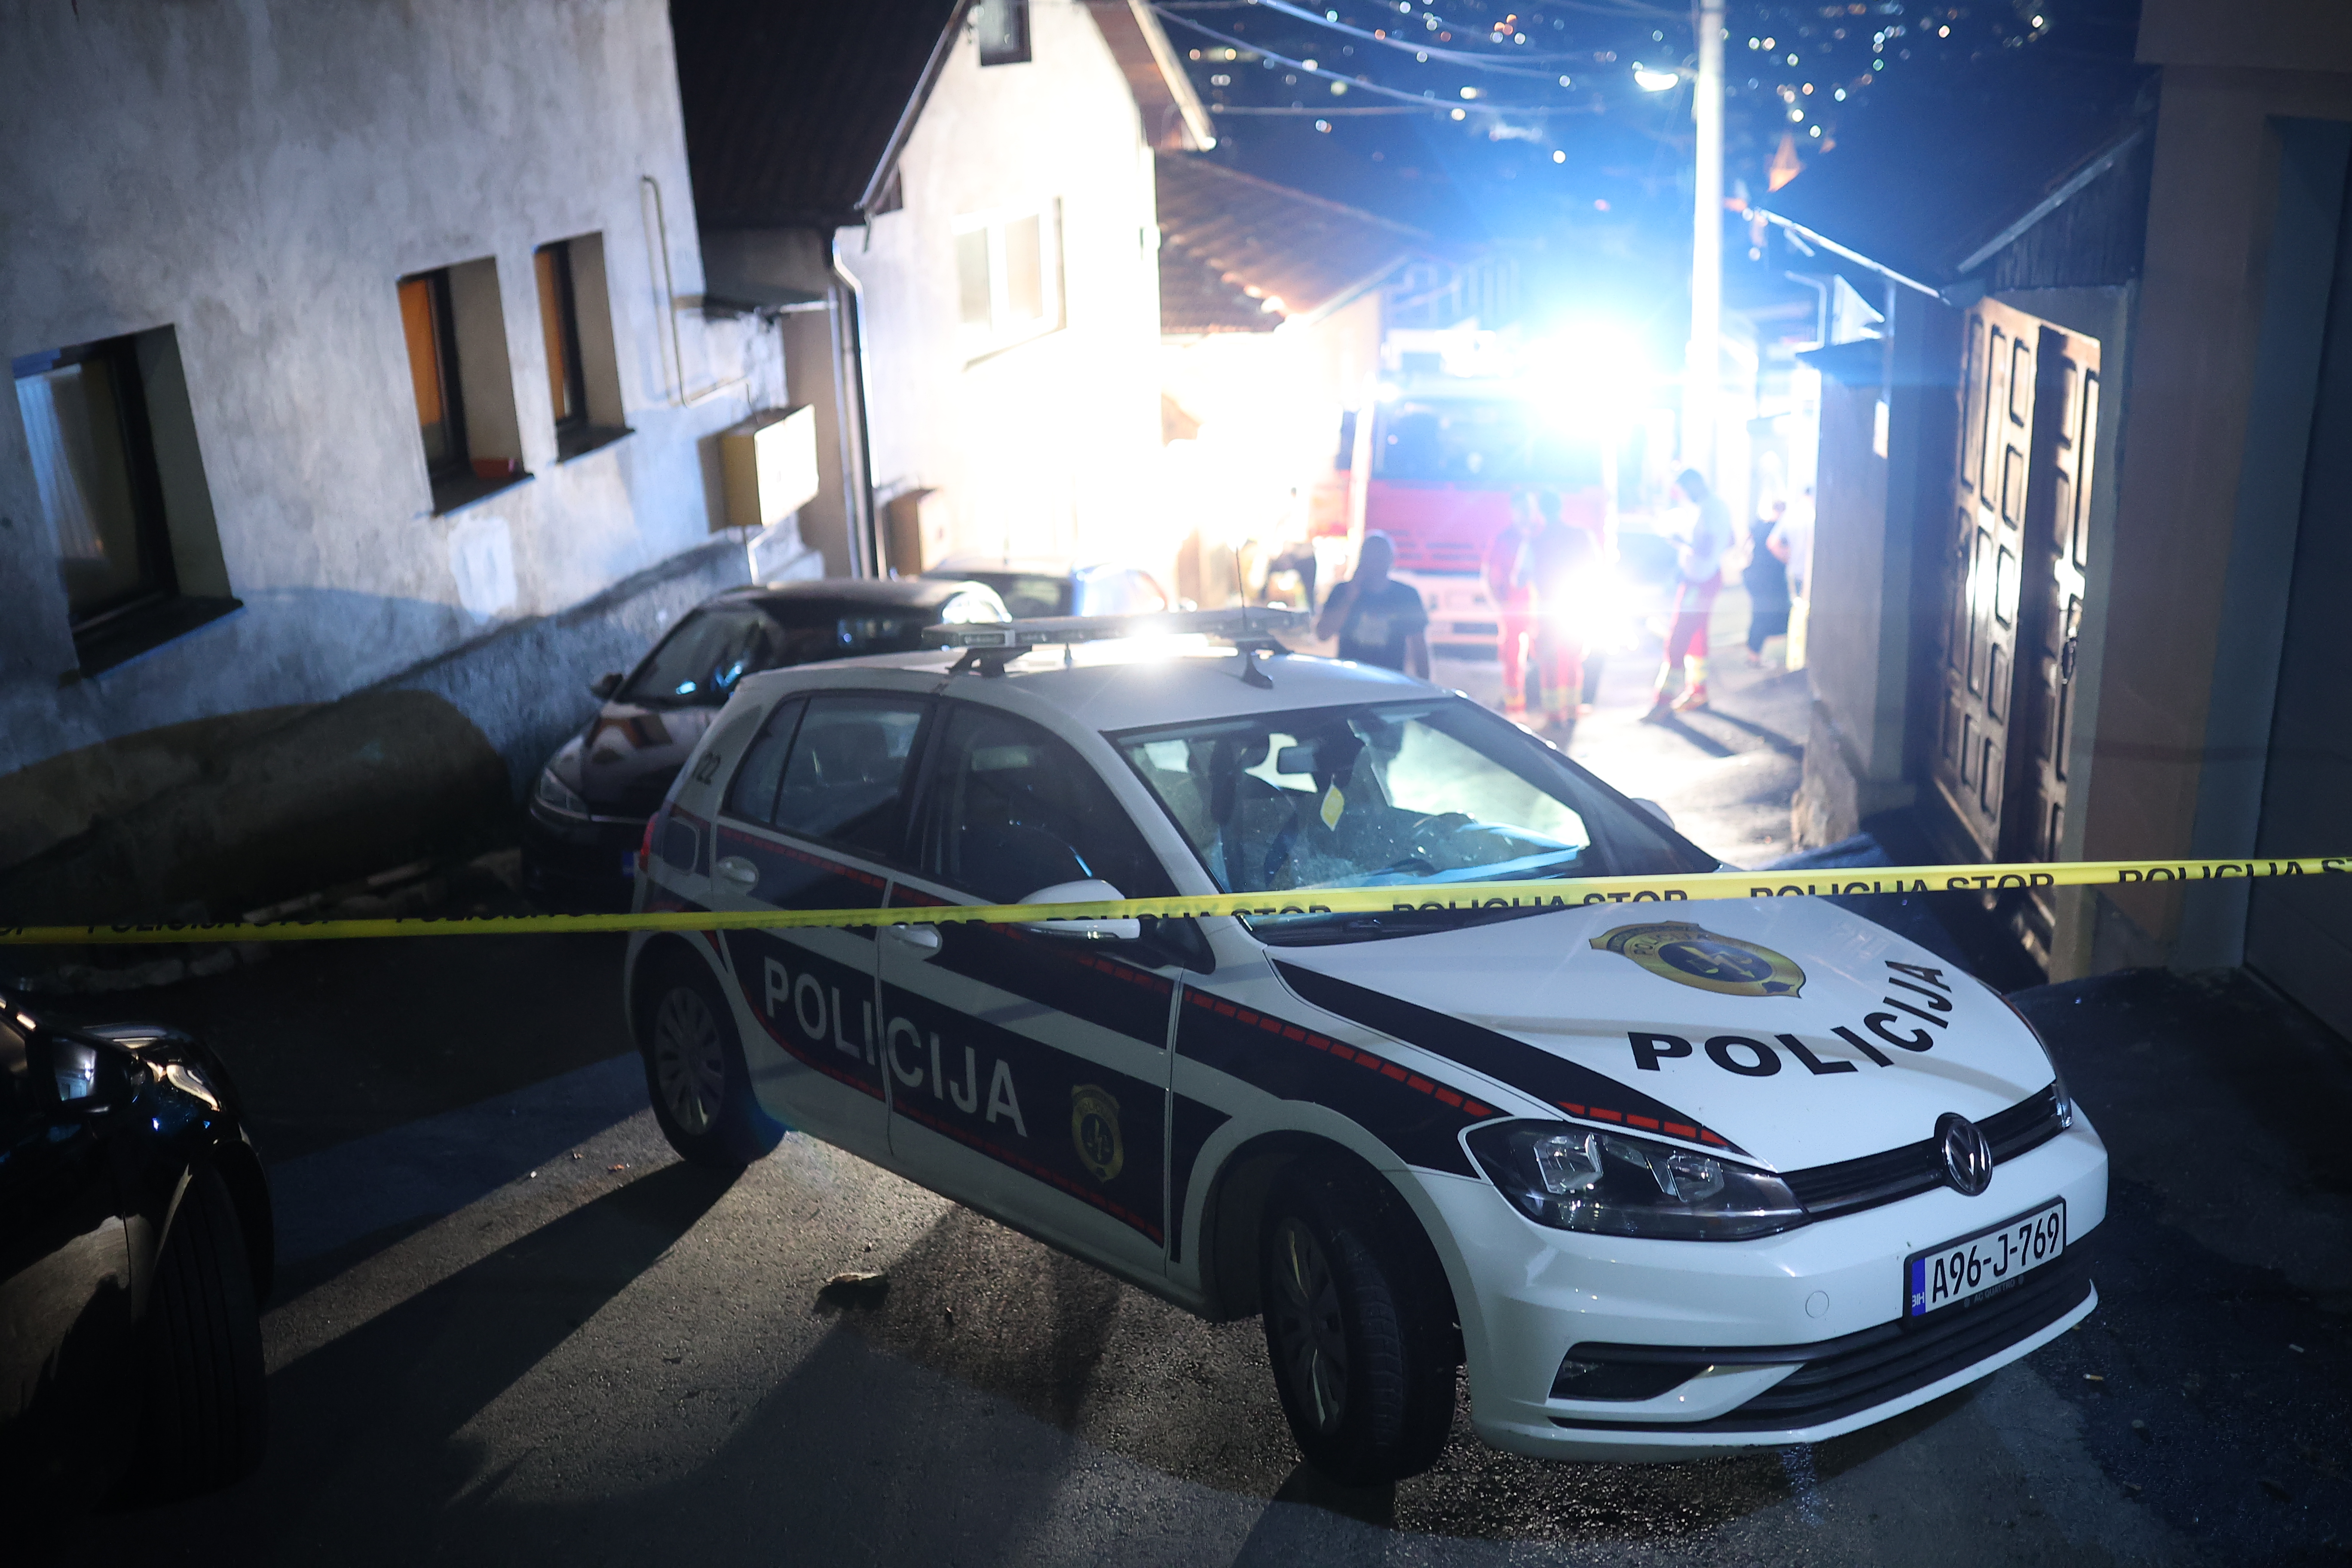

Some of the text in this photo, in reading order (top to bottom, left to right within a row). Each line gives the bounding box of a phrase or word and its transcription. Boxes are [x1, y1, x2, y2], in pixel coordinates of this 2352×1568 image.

[763, 955, 1028, 1138] POLICIJA
[1627, 960, 1953, 1077] POLICIJA
[1912, 1292, 1925, 1308] BIH
[1932, 1212, 2060, 1303] A96-J-769
